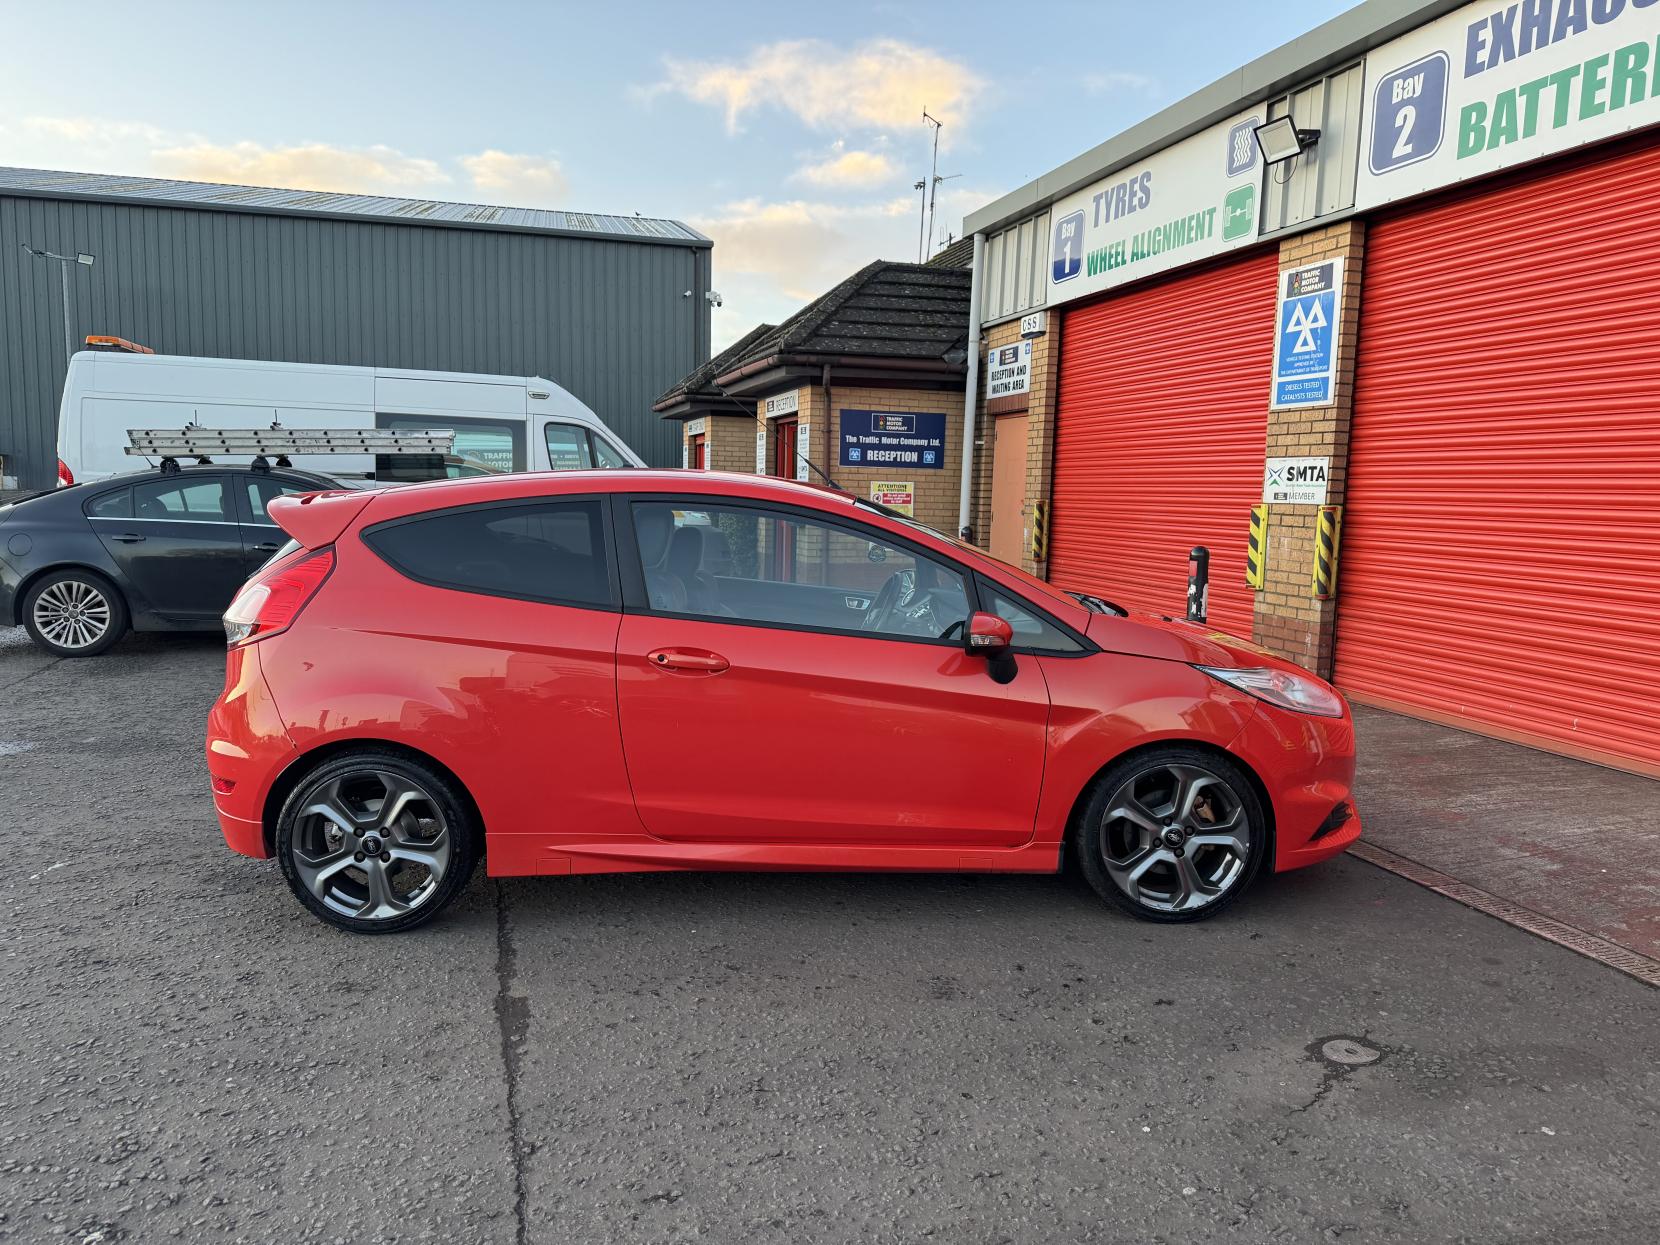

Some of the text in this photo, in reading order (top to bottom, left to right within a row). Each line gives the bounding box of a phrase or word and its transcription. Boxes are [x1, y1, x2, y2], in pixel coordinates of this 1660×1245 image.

[1464, 0, 1655, 79] EXHA
[1392, 73, 1424, 104] Bay
[1391, 105, 1416, 159] 2
[1093, 171, 1152, 228] TYRES
[1061, 221, 1076, 240] Bay
[1087, 207, 1217, 277] WHEEL ALIGNMENT
[1063, 241, 1072, 274] 1
[1301, 277, 1319, 286] MOTOR
[1302, 269, 1320, 279] TRAFFIC
[1301, 282, 1325, 293] COMPANY
[992, 365, 1027, 381] RECEPTION AND
[992, 379, 1025, 394] WAITING AREA
[1285, 381, 1320, 391] DIESELS TESTED
[1281, 392, 1305, 400] CATALYSTS
[845, 435, 858, 443] The
[859, 435, 880, 444] Traffic
[881, 436, 900, 445] Motor
[900, 437, 928, 446] Company
[867, 450, 918, 462] RECEPTION
[1286, 466, 1326, 482] SMTA
[1289, 492, 1316, 500] MEMBER
